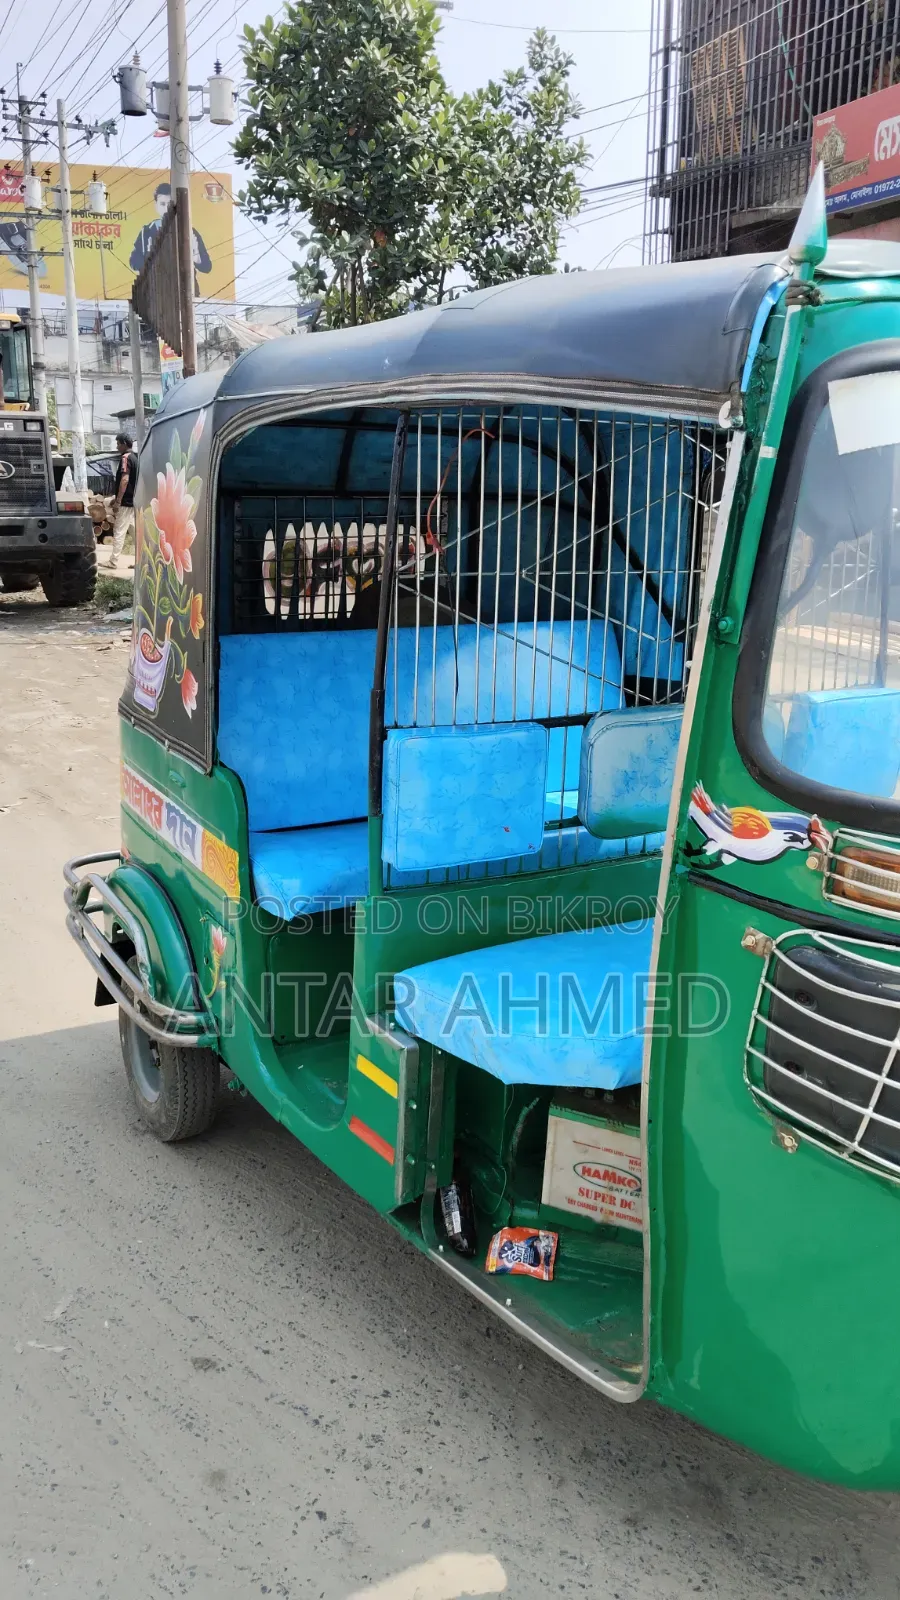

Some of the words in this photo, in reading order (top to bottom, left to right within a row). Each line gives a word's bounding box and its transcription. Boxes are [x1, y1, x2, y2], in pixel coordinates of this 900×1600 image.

[581, 1165, 639, 1189] HAMKO
[577, 1187, 616, 1206] SUPER
[619, 1199, 636, 1211] DC
